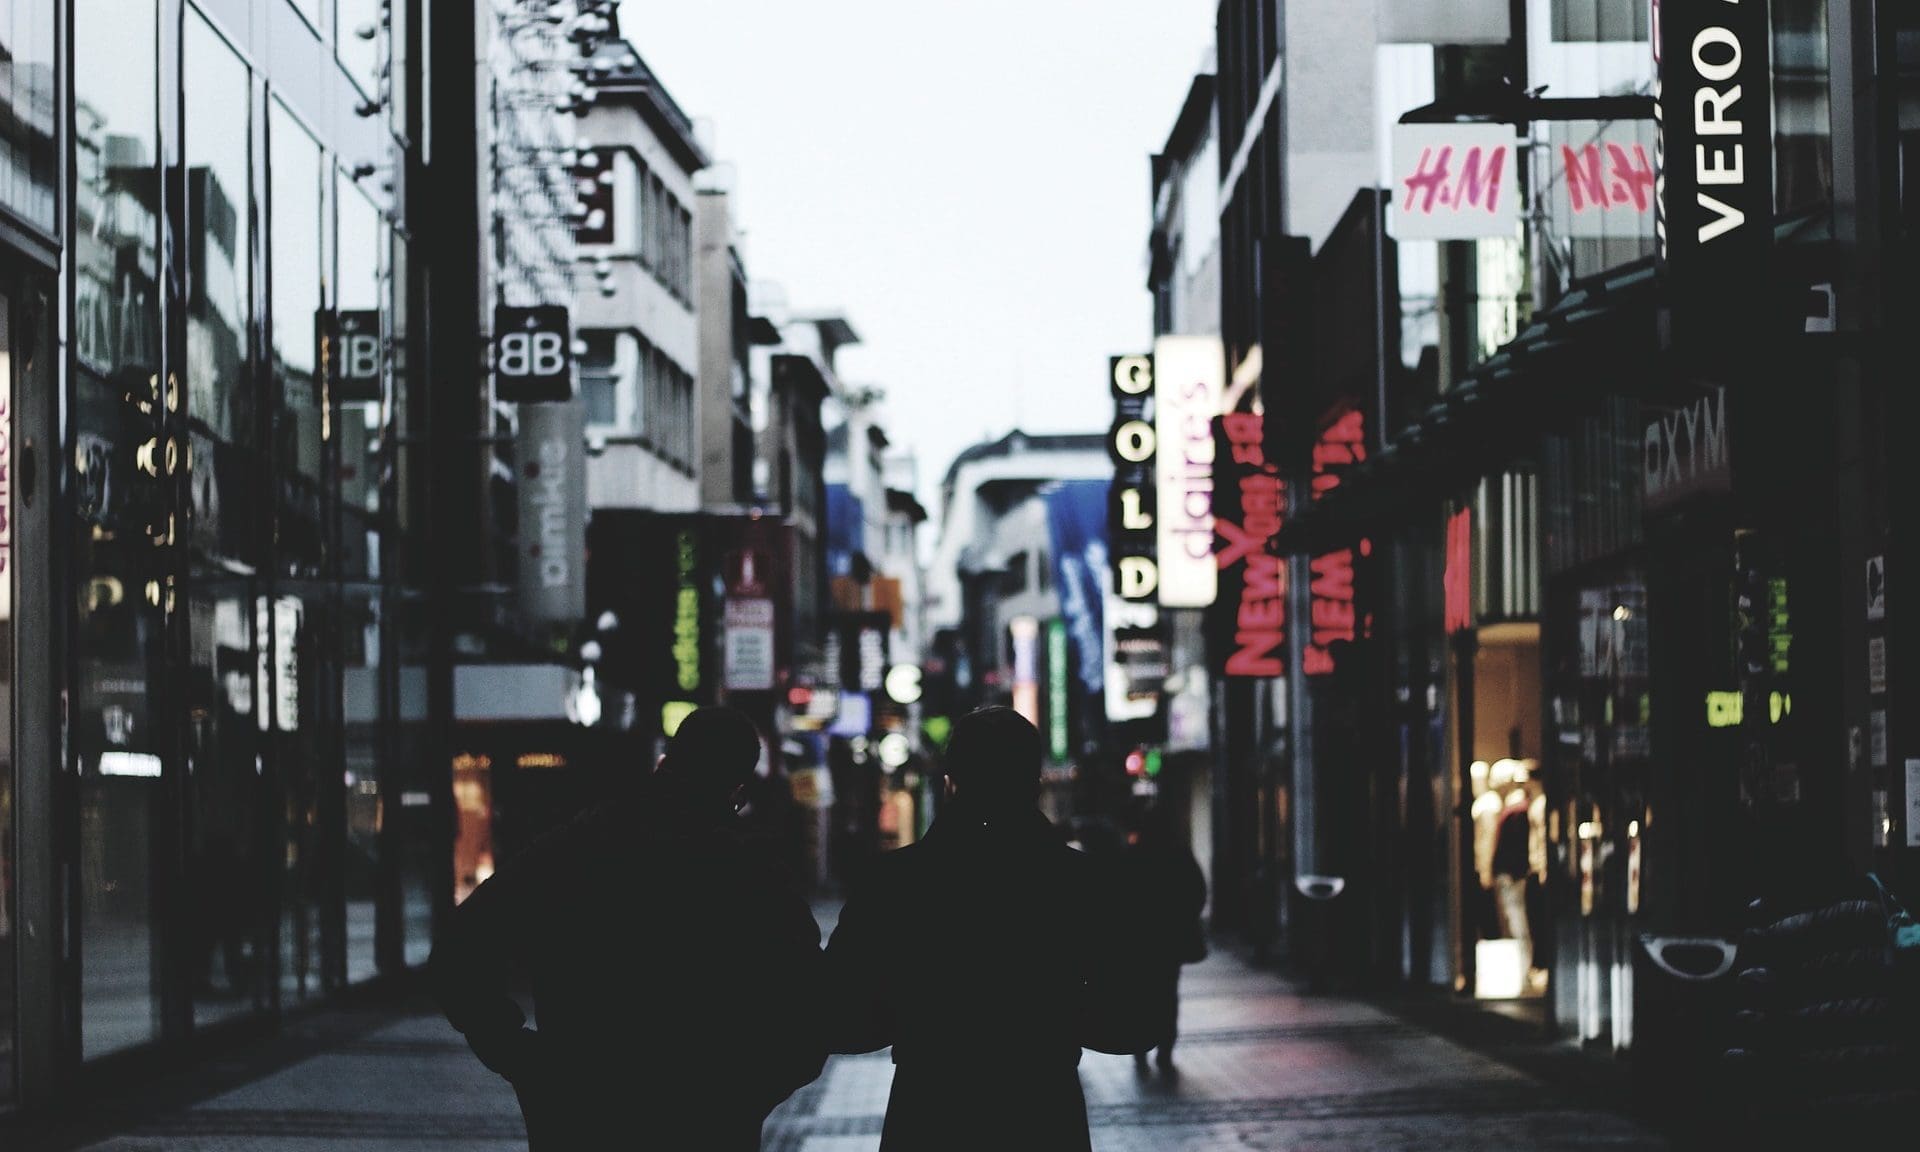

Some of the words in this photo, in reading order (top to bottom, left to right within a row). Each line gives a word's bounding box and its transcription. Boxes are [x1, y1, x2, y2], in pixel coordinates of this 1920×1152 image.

[1404, 144, 1506, 213] H&M
[1691, 26, 1745, 244] VERO
[499, 331, 564, 376] BB
[1113, 354, 1158, 598] GOLD
